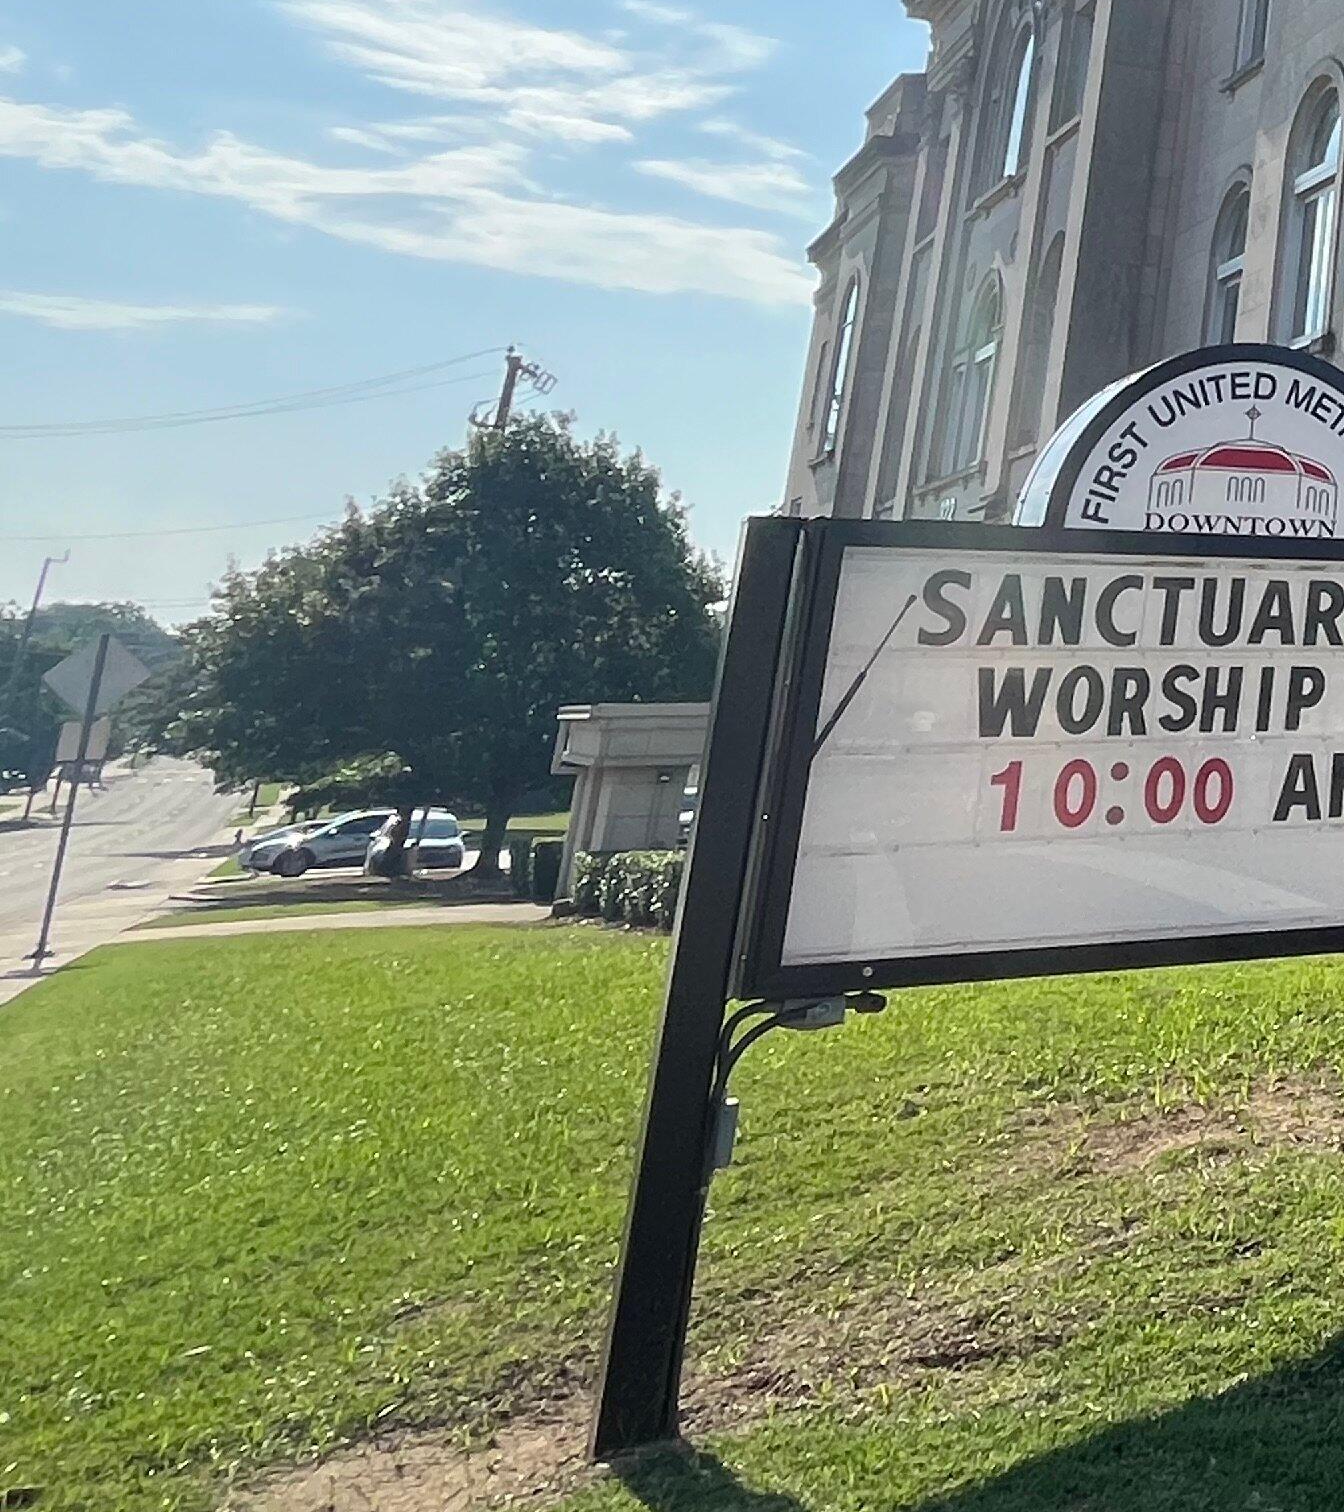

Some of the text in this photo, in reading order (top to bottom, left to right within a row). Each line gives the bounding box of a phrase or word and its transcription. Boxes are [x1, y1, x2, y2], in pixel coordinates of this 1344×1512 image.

[1081, 421, 1148, 524] FIRST
[1148, 371, 1276, 428] UNITED
[1144, 511, 1336, 538] DOWNTOWN
[977, 665, 1327, 738] WORSHIP
[990, 755, 1235, 832] 10:00
